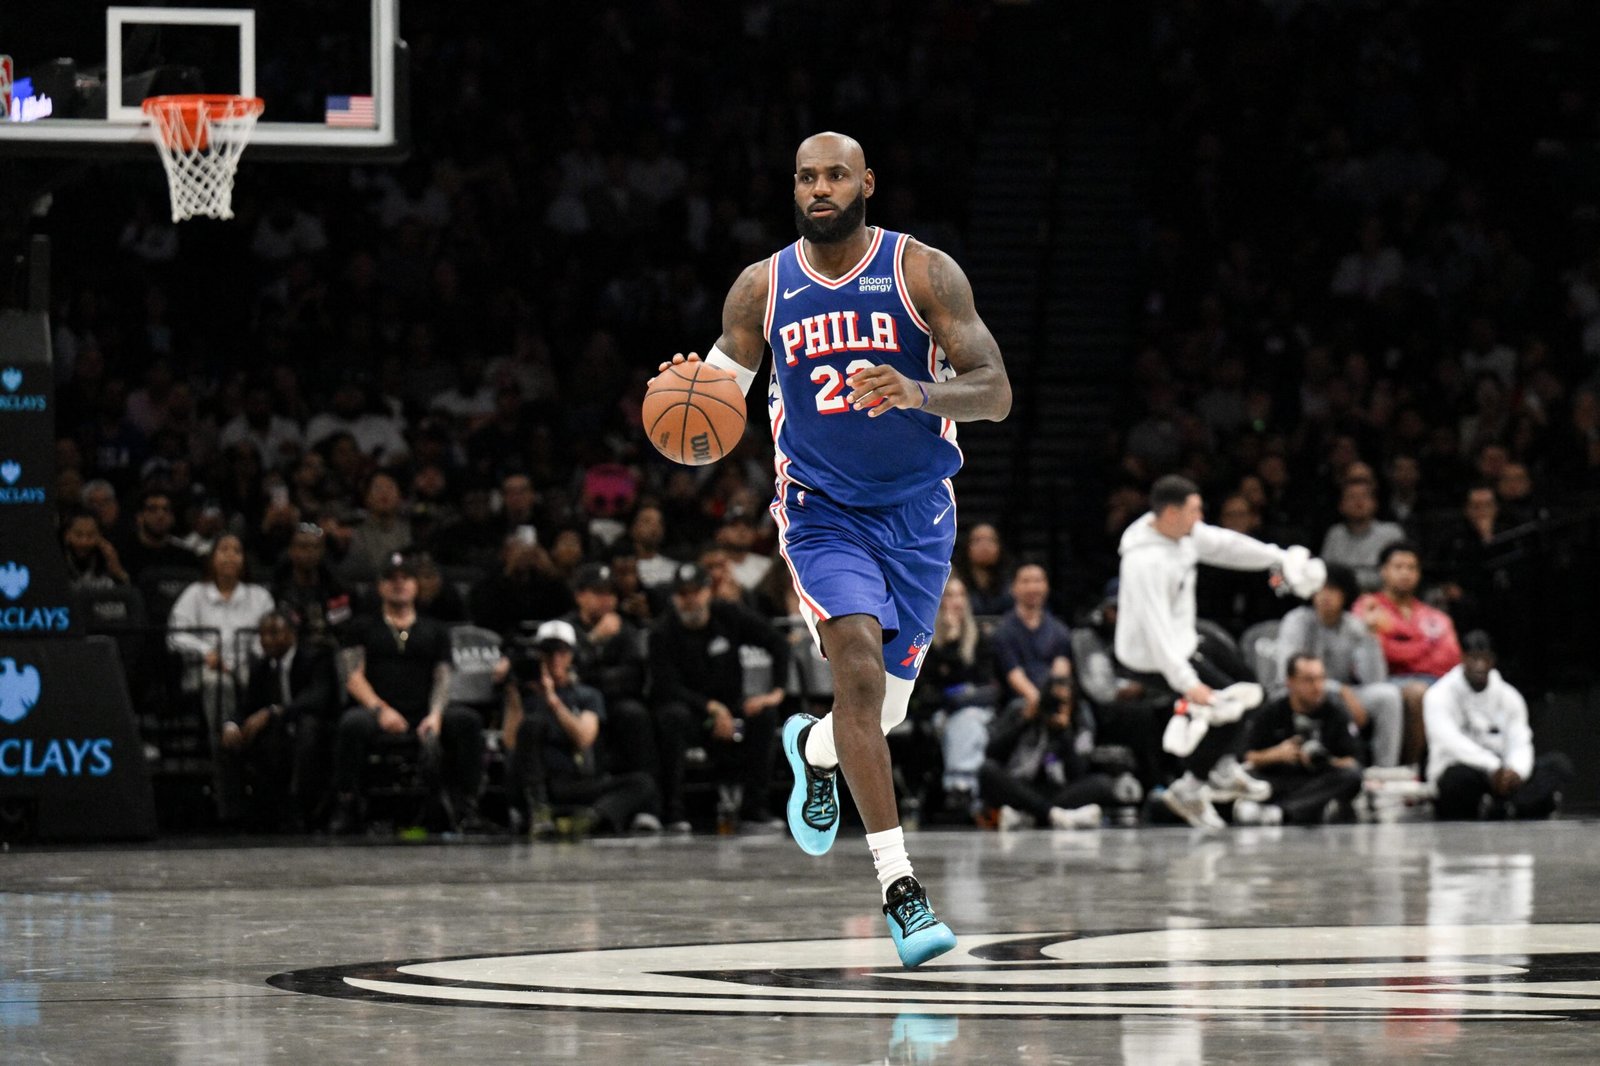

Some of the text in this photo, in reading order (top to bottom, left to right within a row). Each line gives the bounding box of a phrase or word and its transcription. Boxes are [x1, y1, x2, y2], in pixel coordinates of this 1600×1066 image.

[858, 276, 893, 285] Bloom
[858, 283, 893, 293] energy
[779, 310, 901, 367] PHILA
[0, 606, 70, 630] CLAYS
[0, 738, 113, 776] CLAYS
